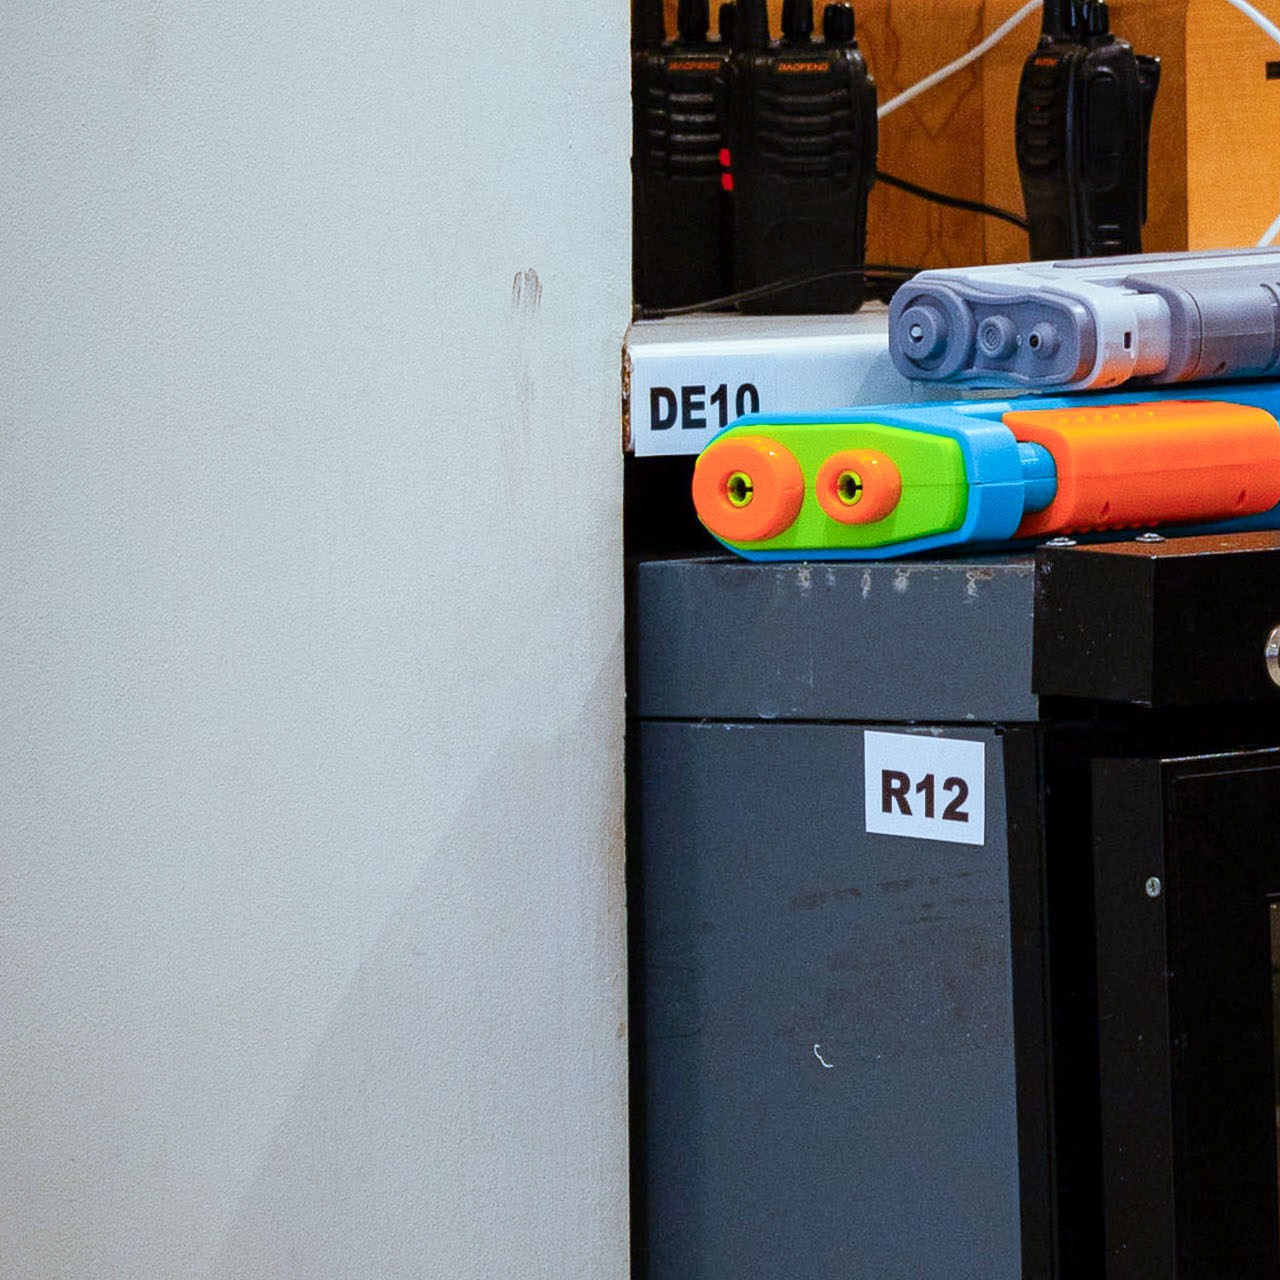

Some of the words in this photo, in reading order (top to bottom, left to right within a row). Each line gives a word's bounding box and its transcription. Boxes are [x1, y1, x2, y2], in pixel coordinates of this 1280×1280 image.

[776, 61, 830, 73] BAOFENG
[649, 383, 760, 431] DE10
[881, 768, 969, 823] R12
